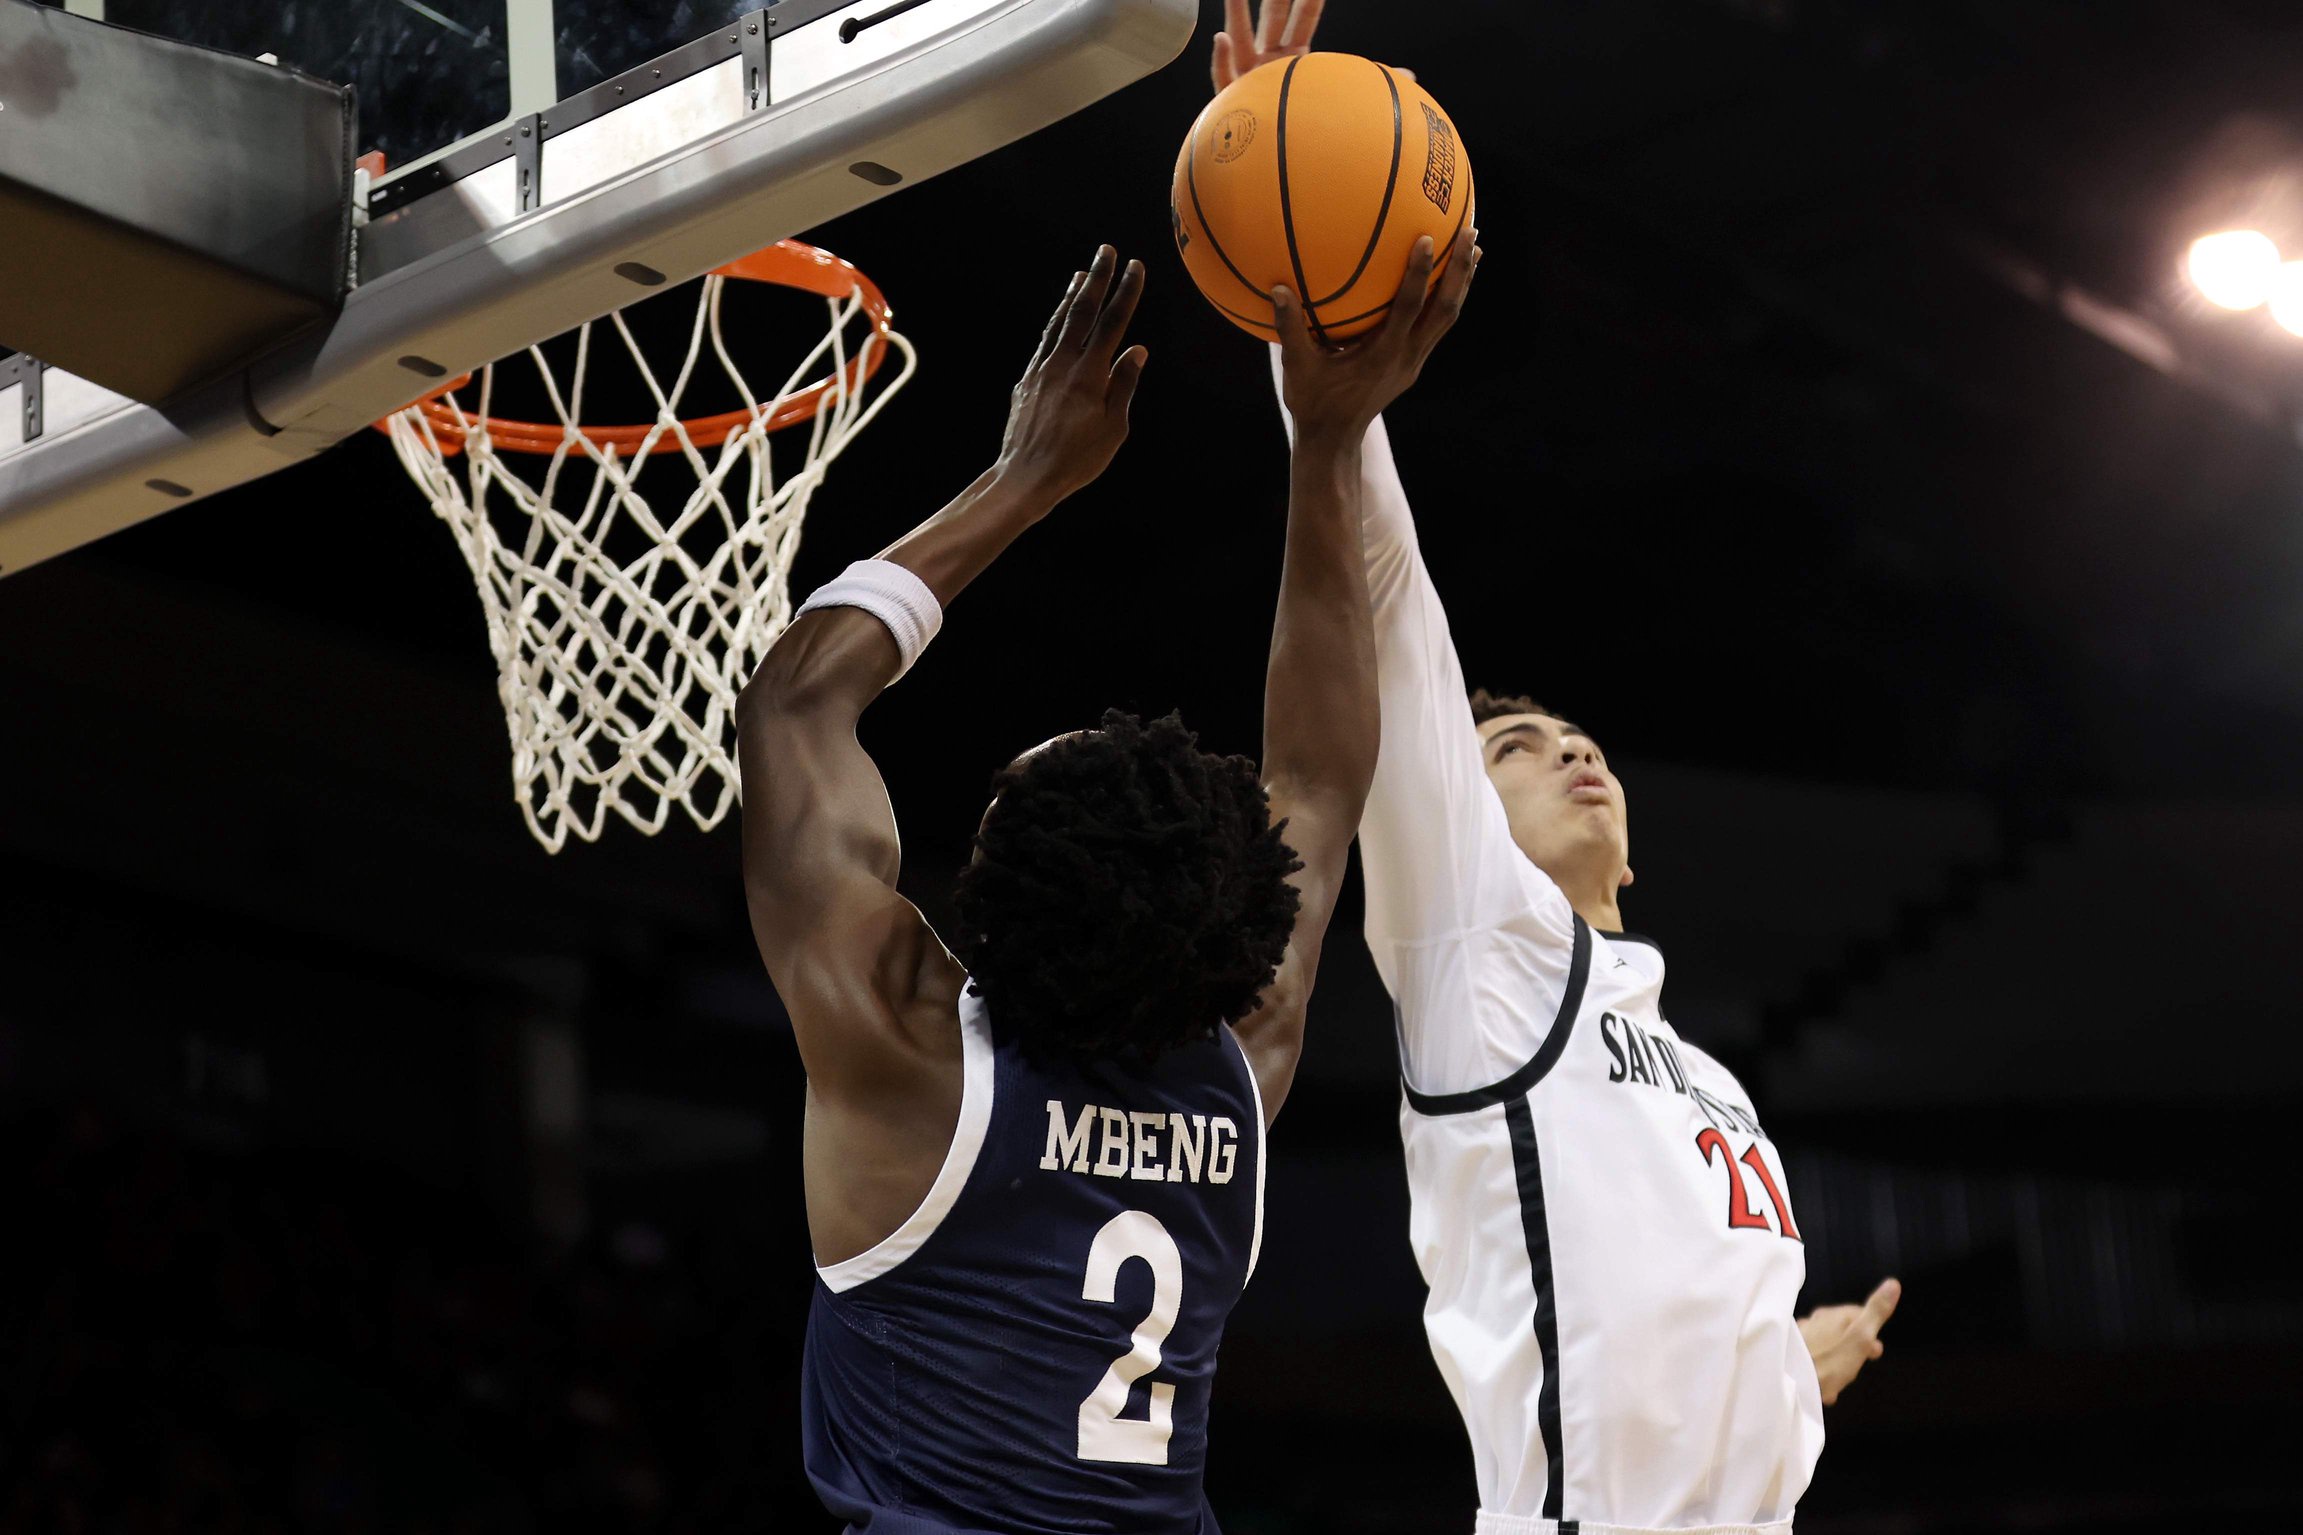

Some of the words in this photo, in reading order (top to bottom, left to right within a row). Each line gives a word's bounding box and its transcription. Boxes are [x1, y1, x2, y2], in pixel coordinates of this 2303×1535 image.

[1425, 131, 1445, 201] MADNESS
[1442, 135, 1455, 185] MARCH
[1600, 1011, 1667, 1092] SAN
[1039, 1100, 1238, 1184] MBENG
[1696, 1127, 1804, 1244] 21
[1077, 1210, 1182, 1465] 2
